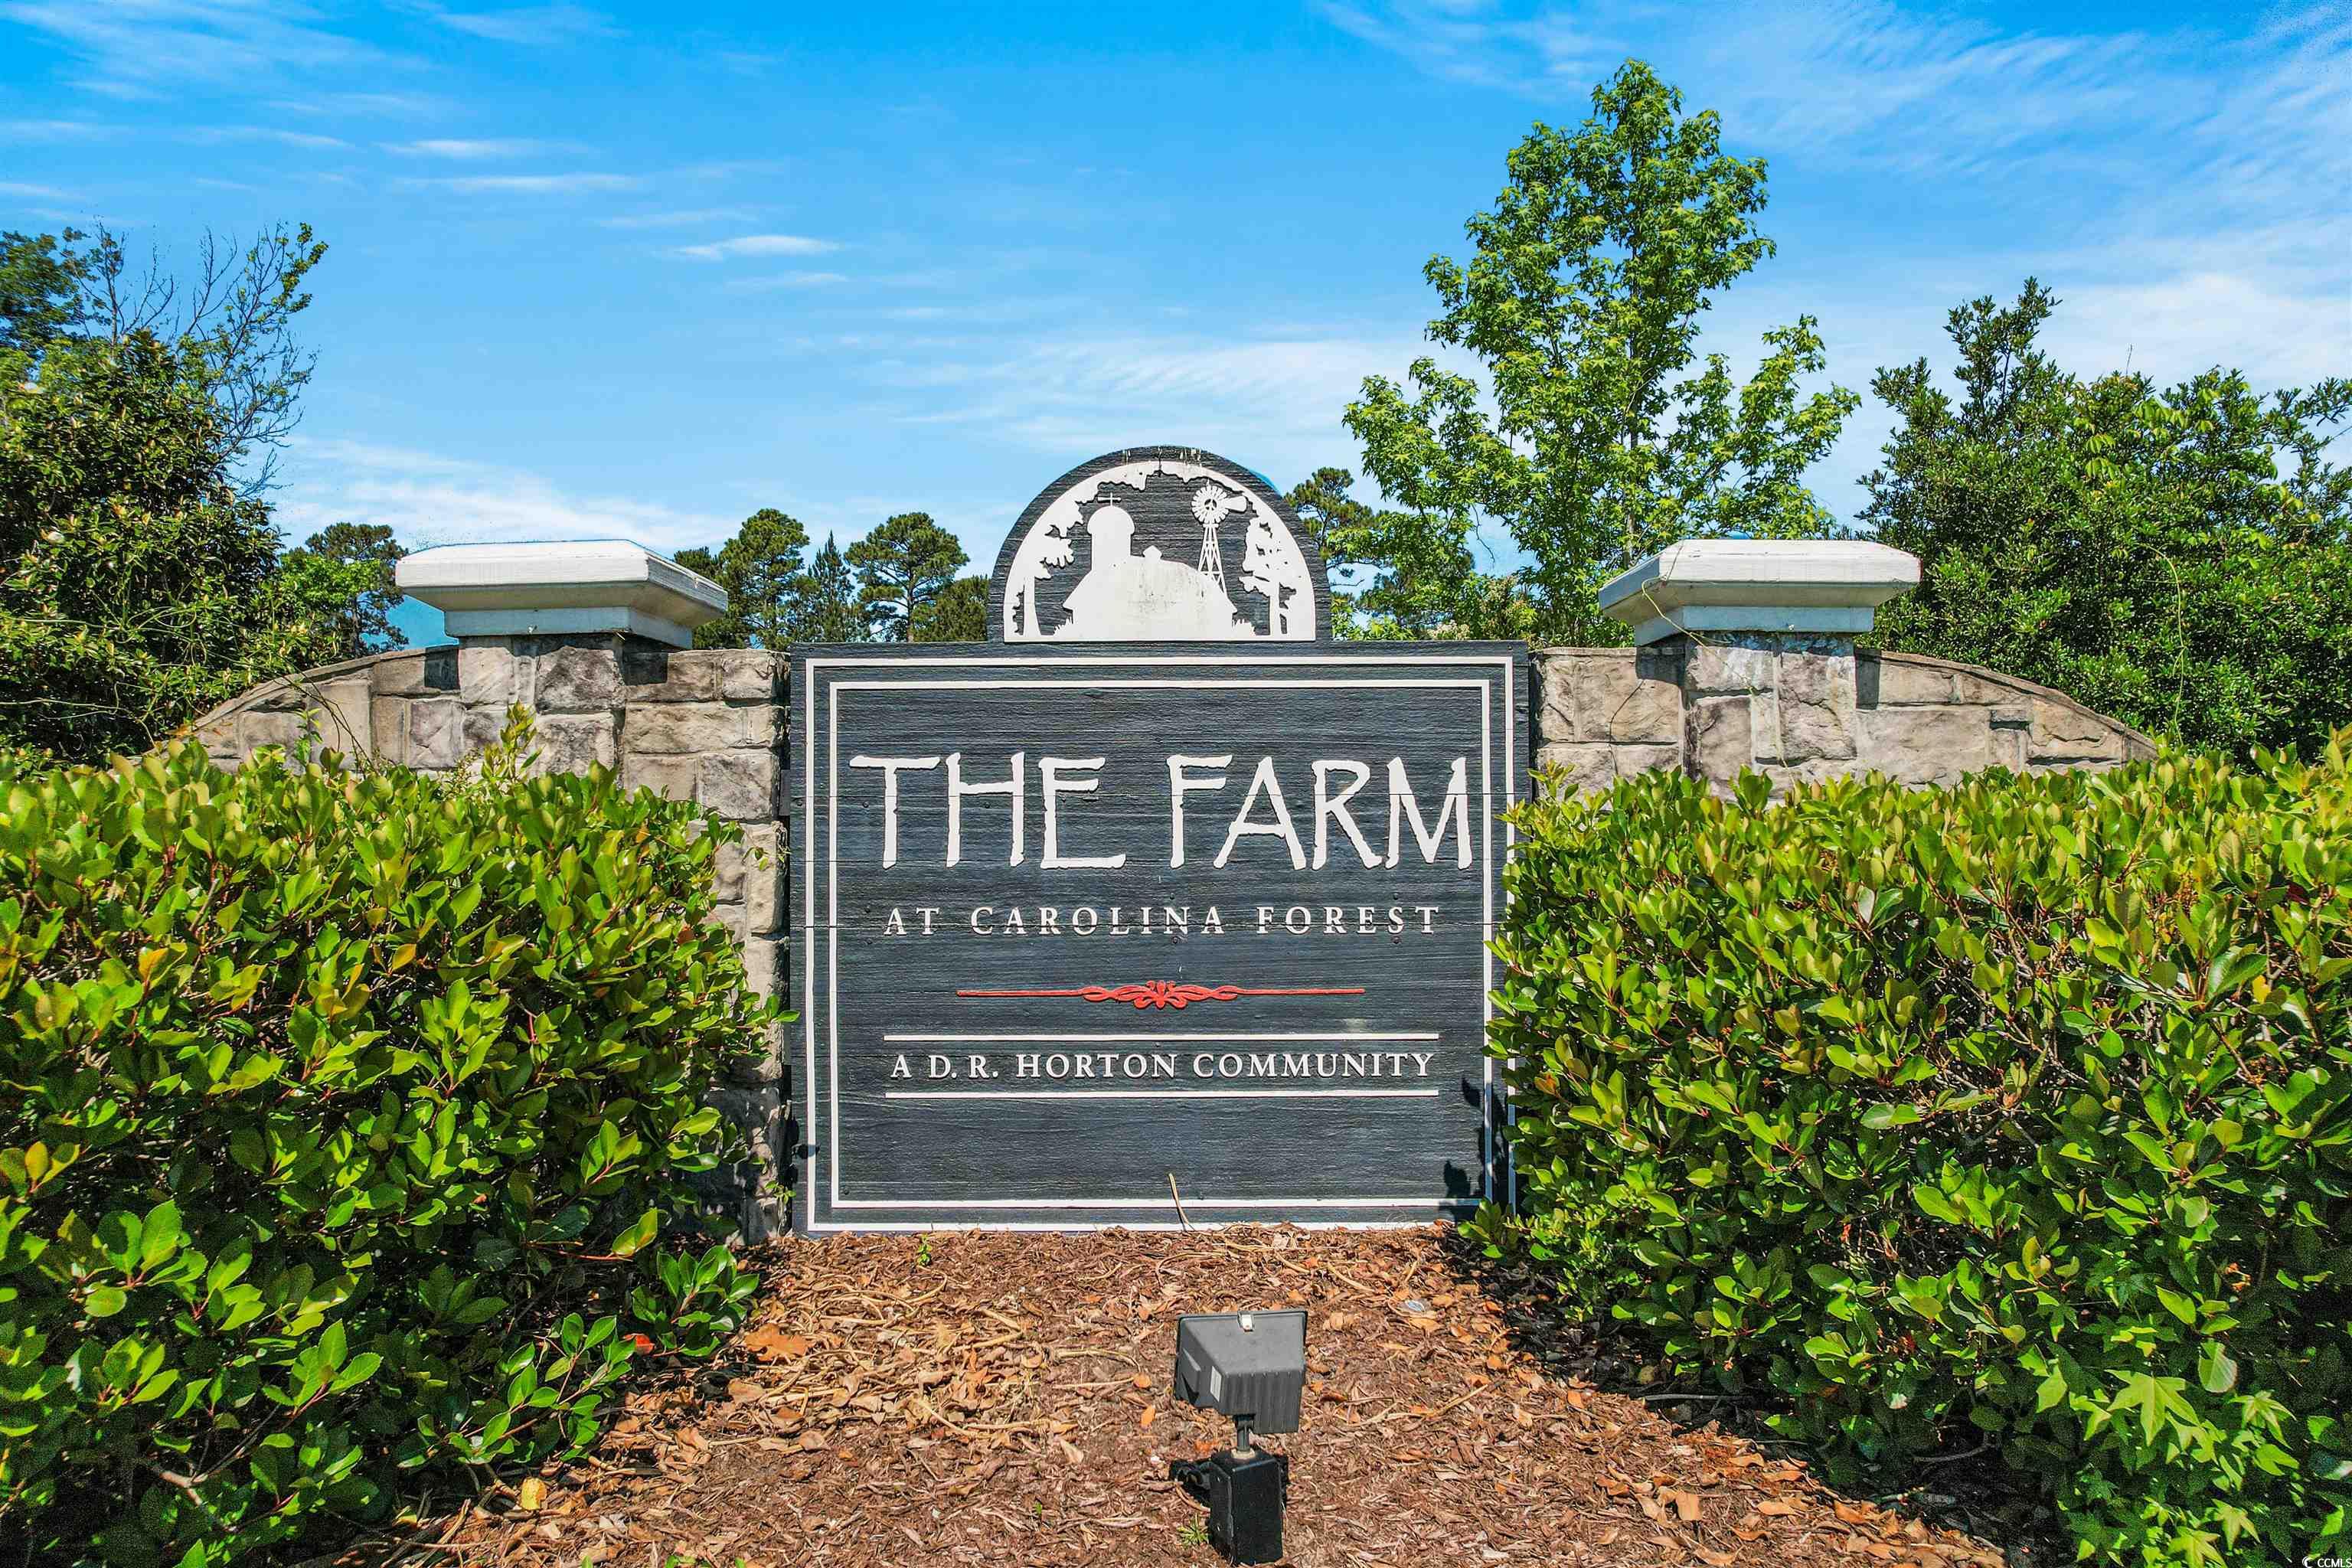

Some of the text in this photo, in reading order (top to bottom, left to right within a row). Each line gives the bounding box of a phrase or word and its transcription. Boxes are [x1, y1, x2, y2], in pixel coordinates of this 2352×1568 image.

[849, 751, 1473, 871] THE FARM
[884, 906, 1439, 936] AT CAROLINA FOREST
[890, 1054, 912, 1077] A
[1016, 1054, 1178, 1077] HORTON
[1194, 1052, 1437, 1076] COMMUNITY
